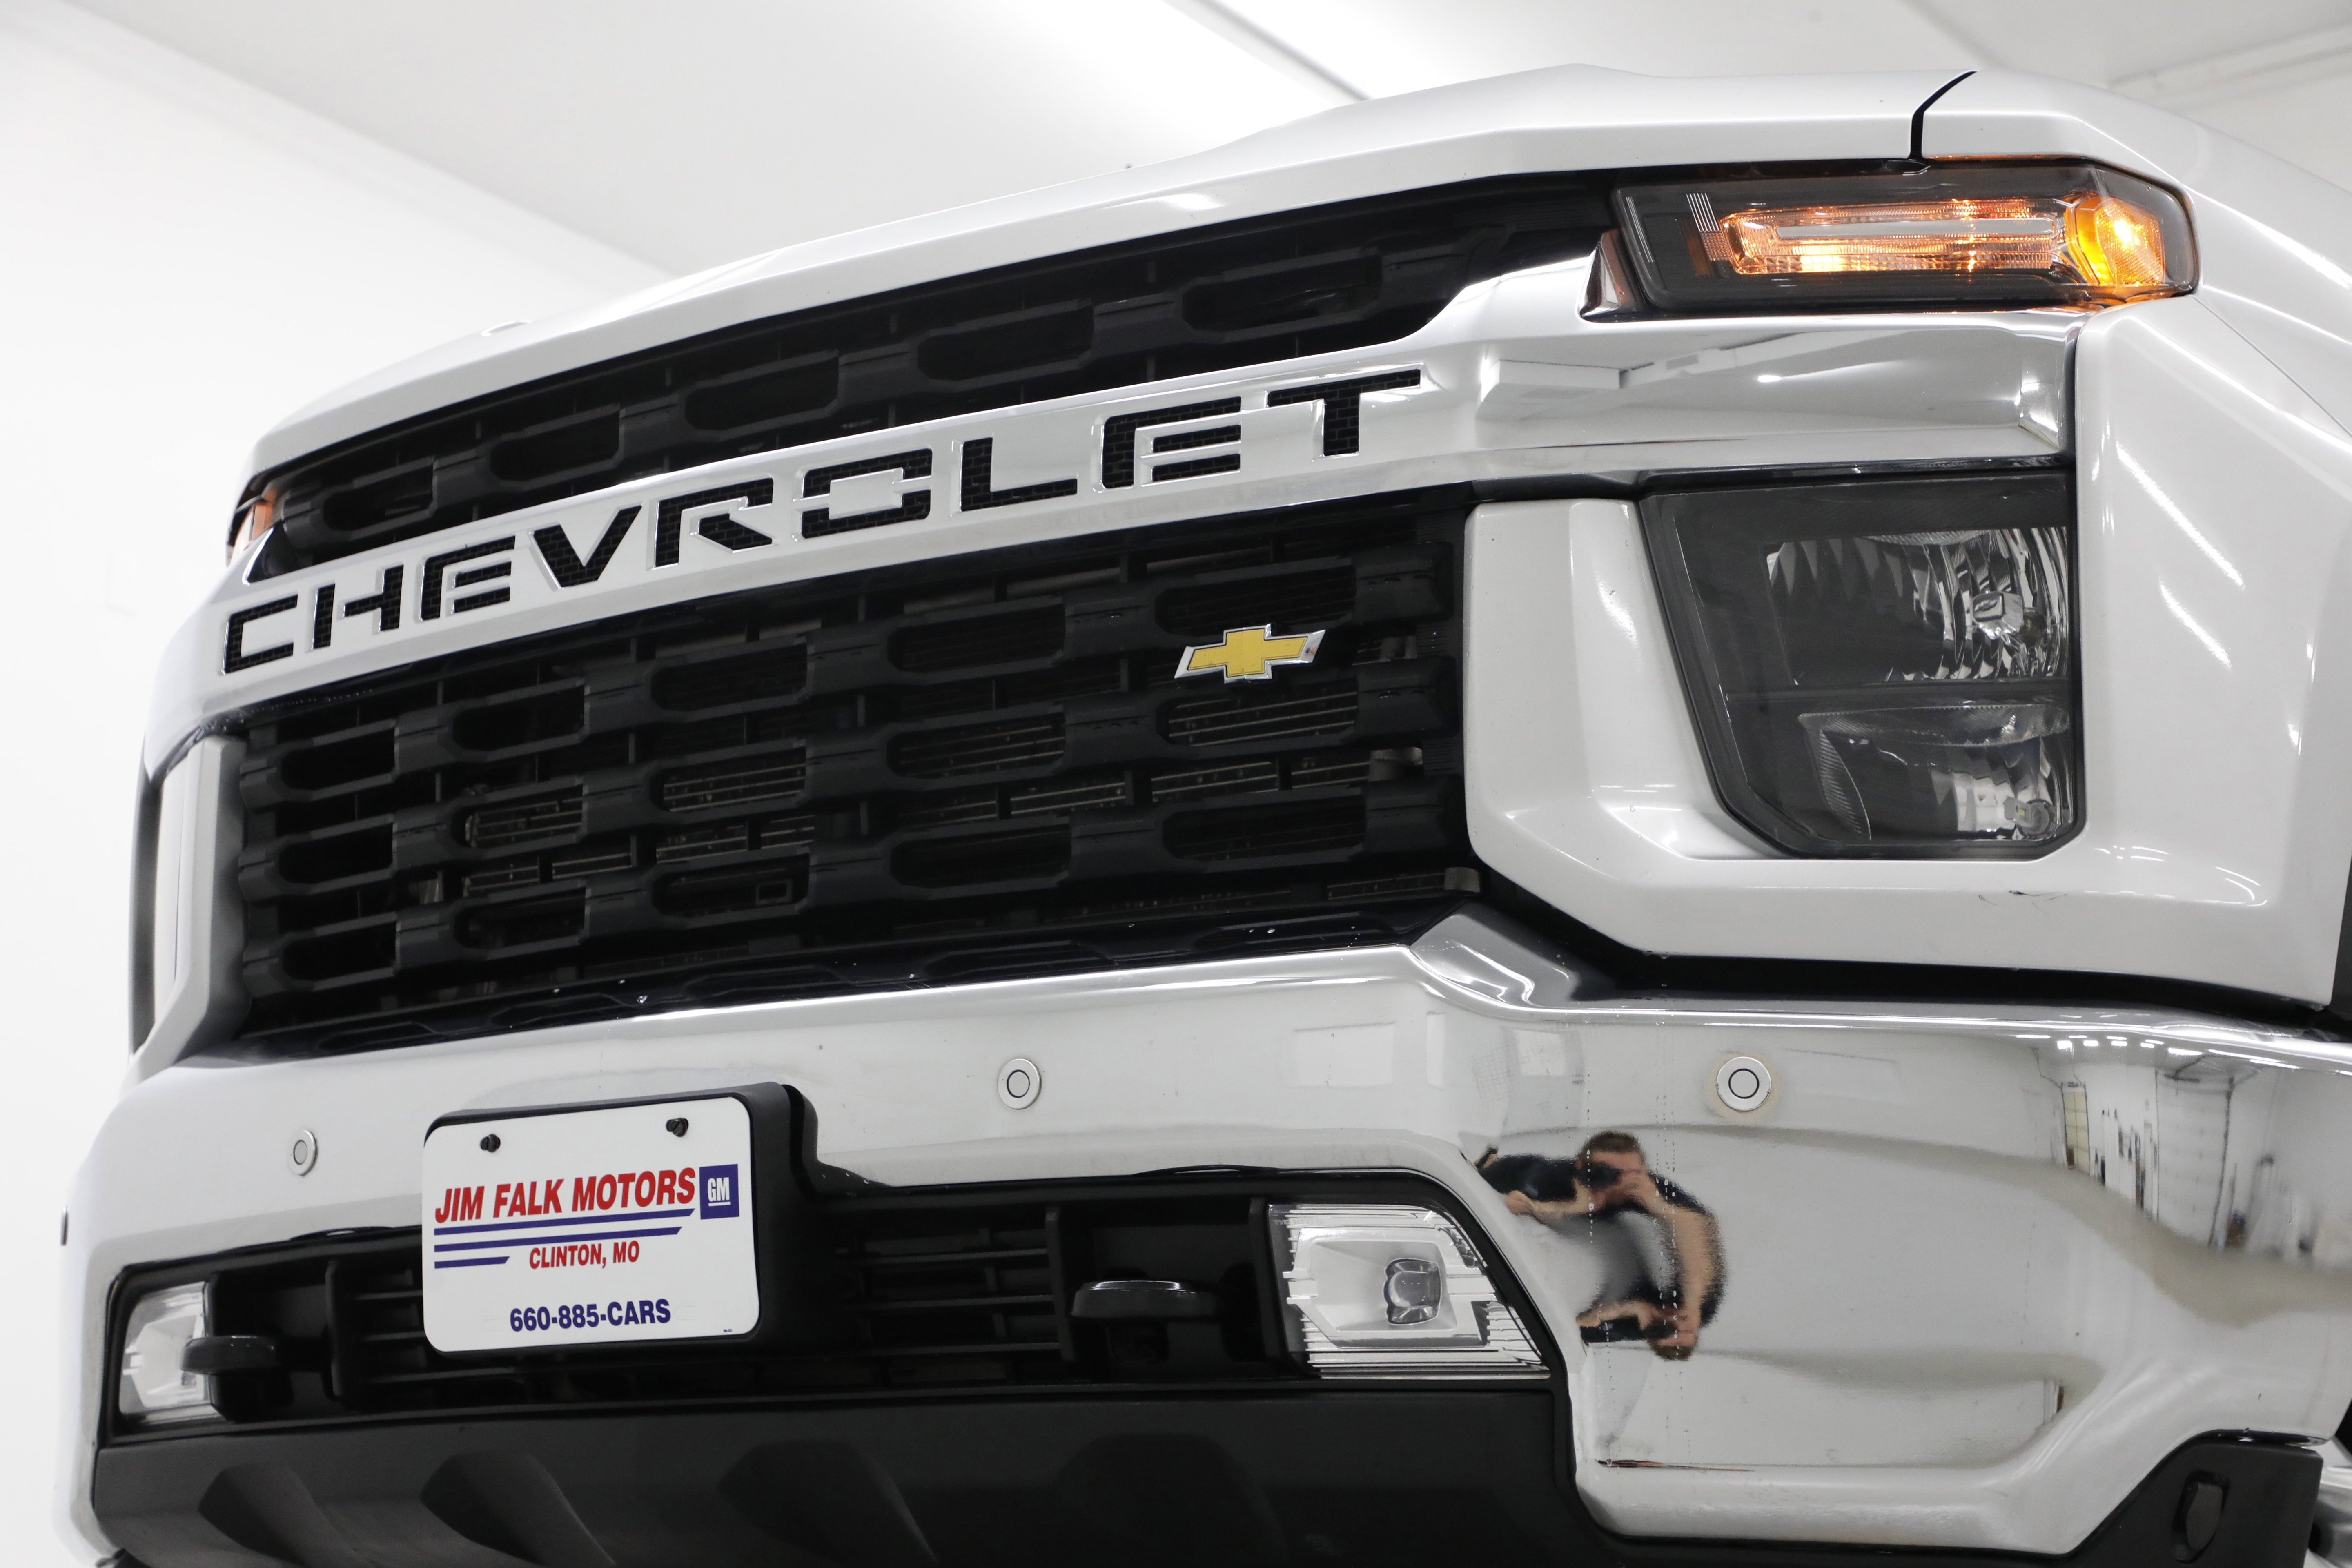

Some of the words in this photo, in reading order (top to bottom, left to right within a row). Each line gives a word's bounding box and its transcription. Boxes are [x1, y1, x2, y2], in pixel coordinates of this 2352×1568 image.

[222, 368, 1422, 675] CHEVROLET
[435, 1185, 485, 1223] JIM
[493, 1178, 564, 1218] FALK
[572, 1167, 696, 1212] MOTORS
[707, 1176, 731, 1203] GM
[529, 1243, 606, 1269] CLINTON,
[613, 1240, 640, 1263] MO
[510, 1298, 671, 1332] 660-885-CARS
